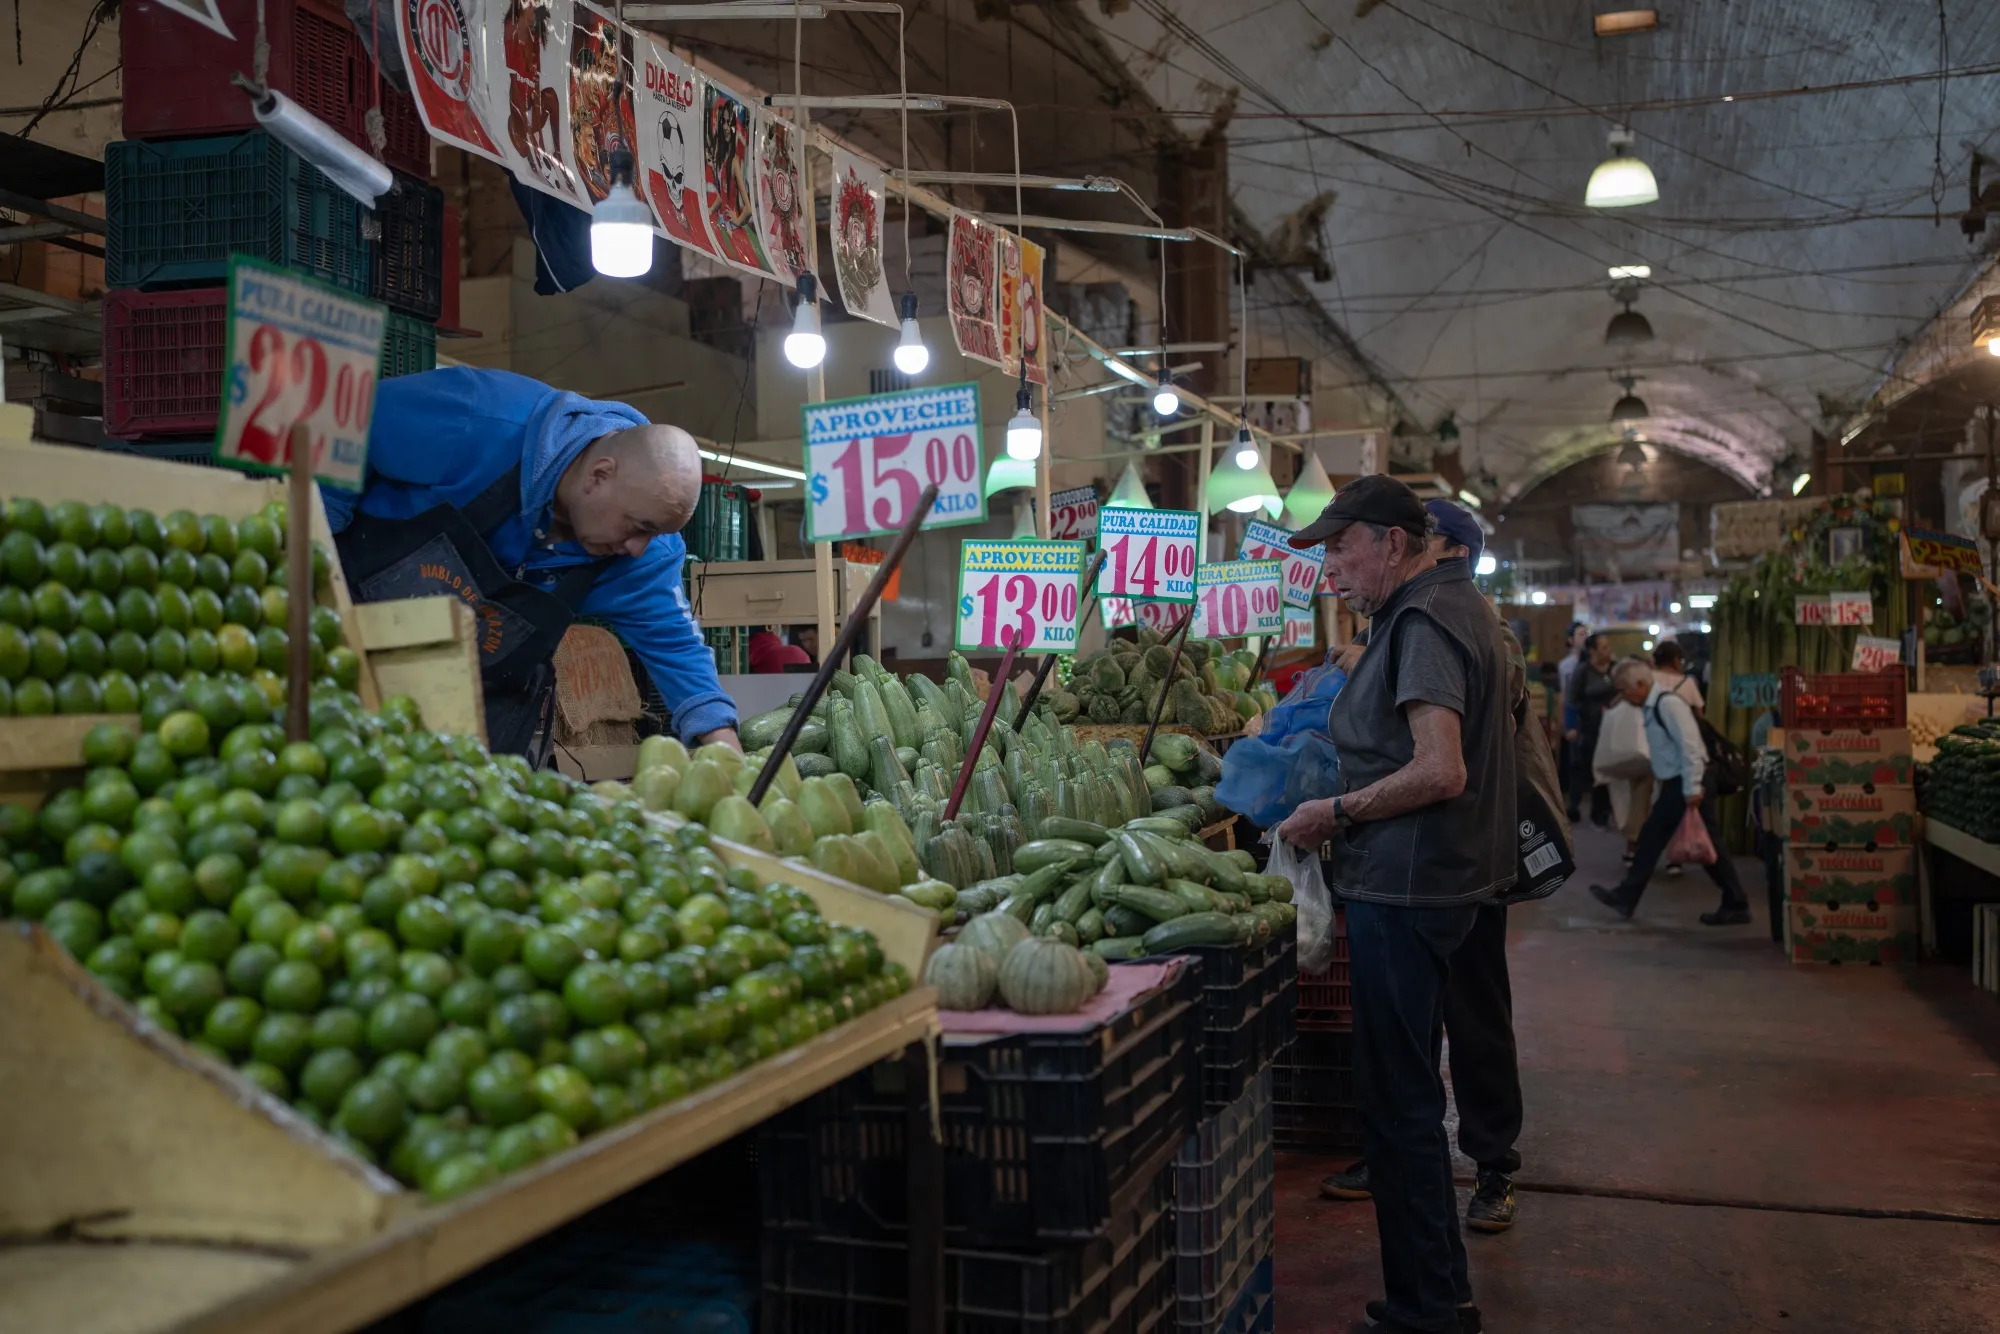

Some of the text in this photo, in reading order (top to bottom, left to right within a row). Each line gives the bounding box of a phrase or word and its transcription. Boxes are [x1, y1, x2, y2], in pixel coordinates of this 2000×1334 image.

[645, 60, 693, 107] DIABLO
[653, 91, 665, 103] HASTA
[672, 99, 687, 113] MUERTE
[810, 397, 970, 435] APROVECHE
[933, 492, 978, 514] KILO
[1101, 515, 1197, 531] PURA CALIDAD
[1249, 524, 1277, 543] PURA
[966, 551, 1081, 565] APROVECHE
[1199, 564, 1279, 581] URA CALIDAD
[420, 563, 462, 589] DIABLO
[461, 585, 479, 605] DE
[1166, 580, 1194, 594] KILO
[1287, 587, 1310, 602] KILO
[1257, 616, 1282, 627] KILO
[1043, 627, 1075, 642] KILO
[1815, 737, 1880, 750] VEGETABLES
[1817, 797, 1883, 810] VEGETABLES
